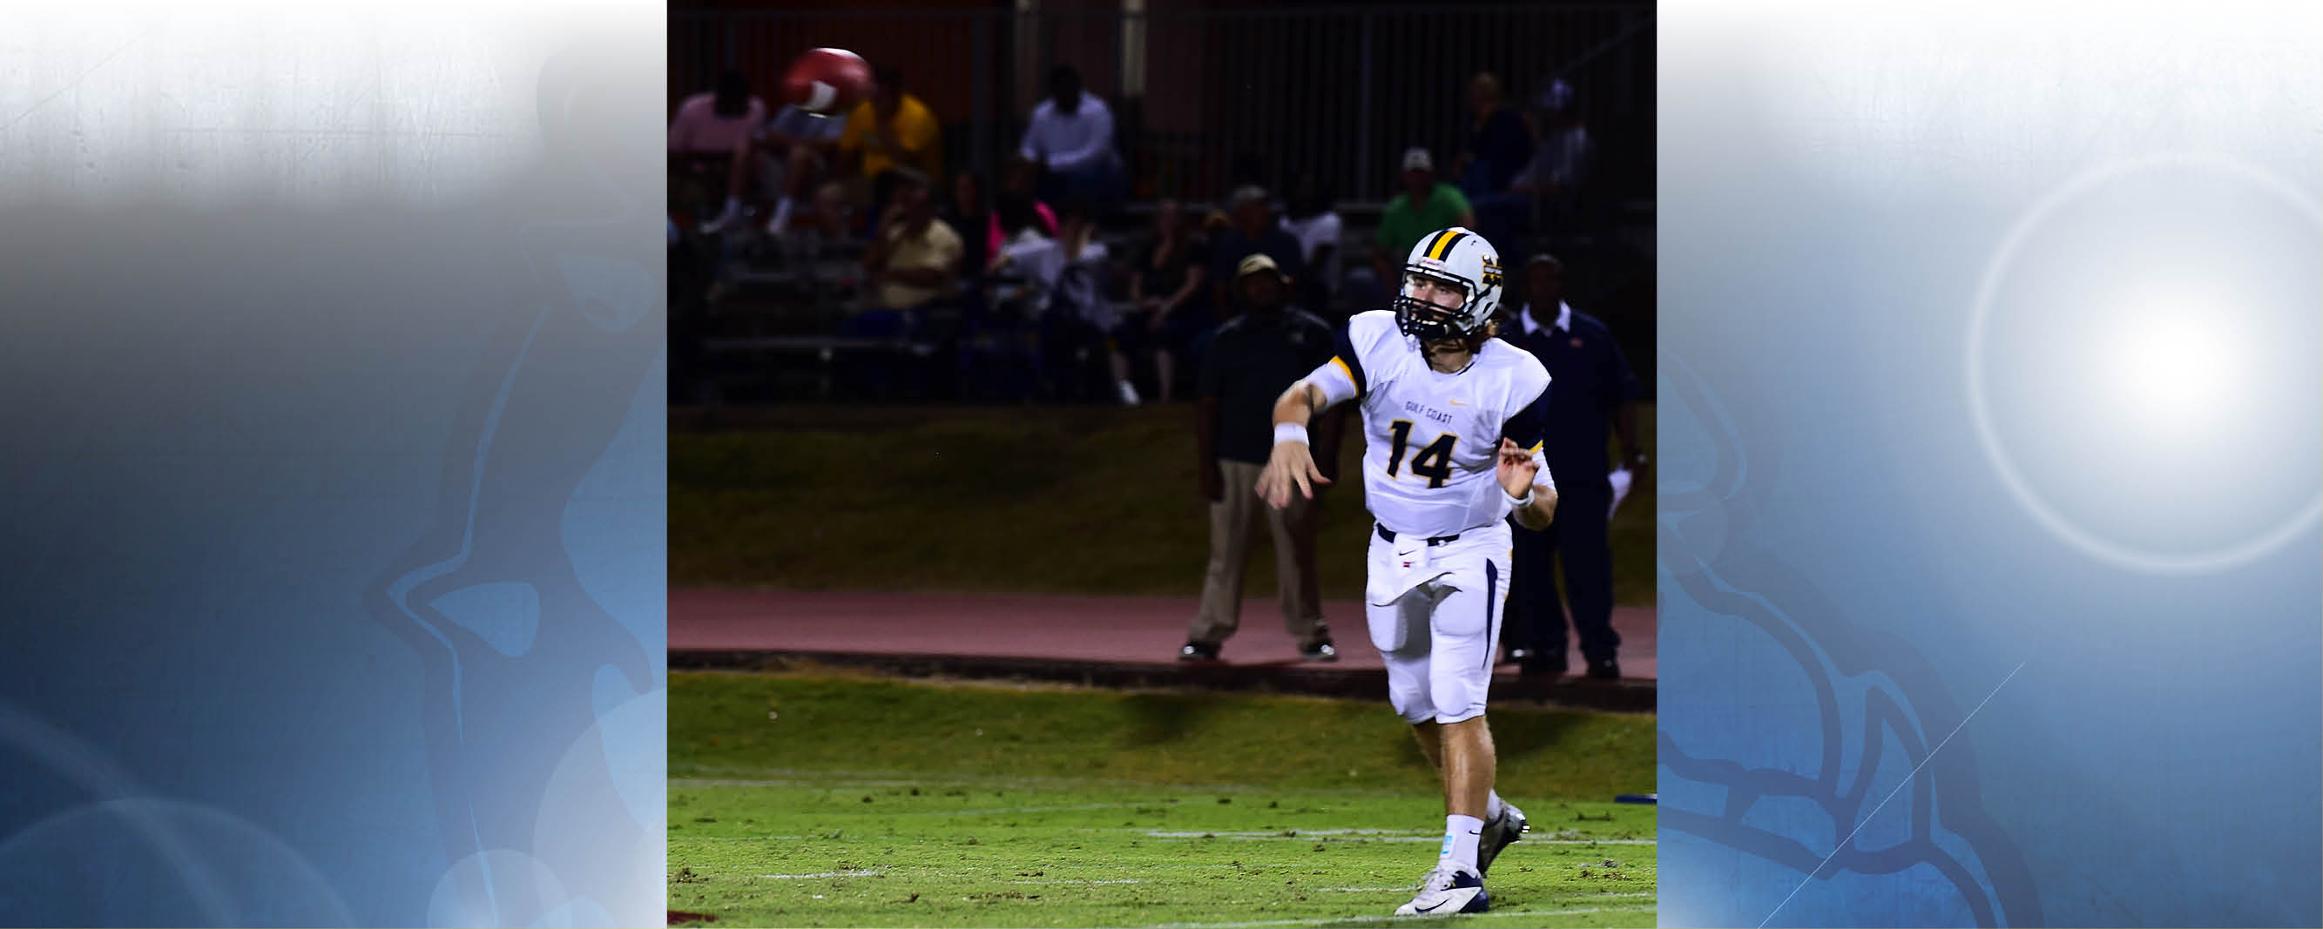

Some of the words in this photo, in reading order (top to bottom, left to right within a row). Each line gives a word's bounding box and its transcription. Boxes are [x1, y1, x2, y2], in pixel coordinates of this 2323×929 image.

[1405, 401, 1425, 414] GULF
[1426, 408, 1453, 424] COAST
[1386, 418, 1458, 489] 14
